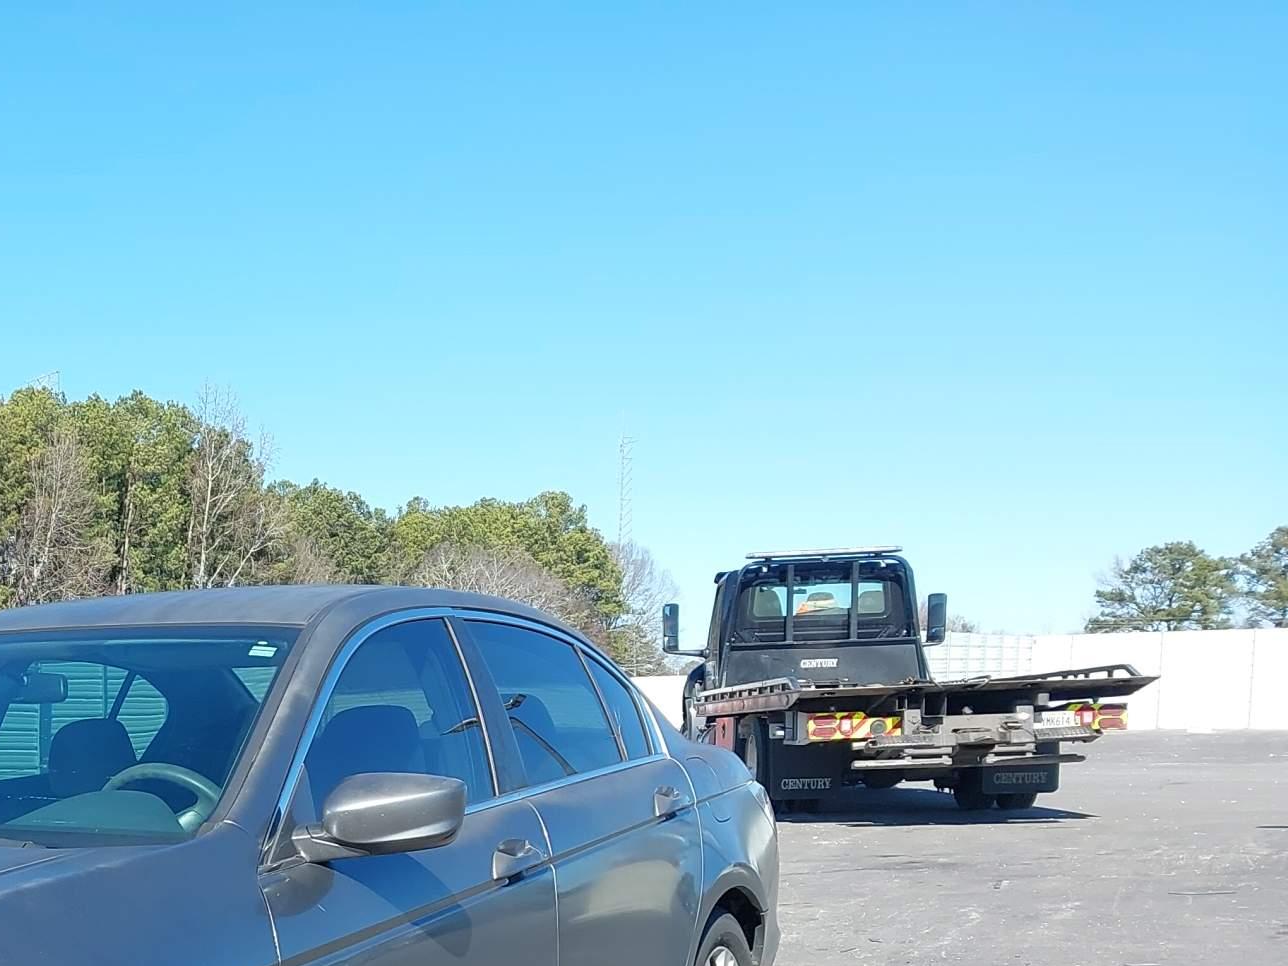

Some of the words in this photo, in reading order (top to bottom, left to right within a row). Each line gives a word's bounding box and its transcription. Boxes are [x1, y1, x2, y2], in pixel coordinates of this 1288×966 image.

[800, 658, 838, 668] CENTURY
[781, 778, 832, 790] CENTURY
[993, 772, 1048, 784] CENTURY
